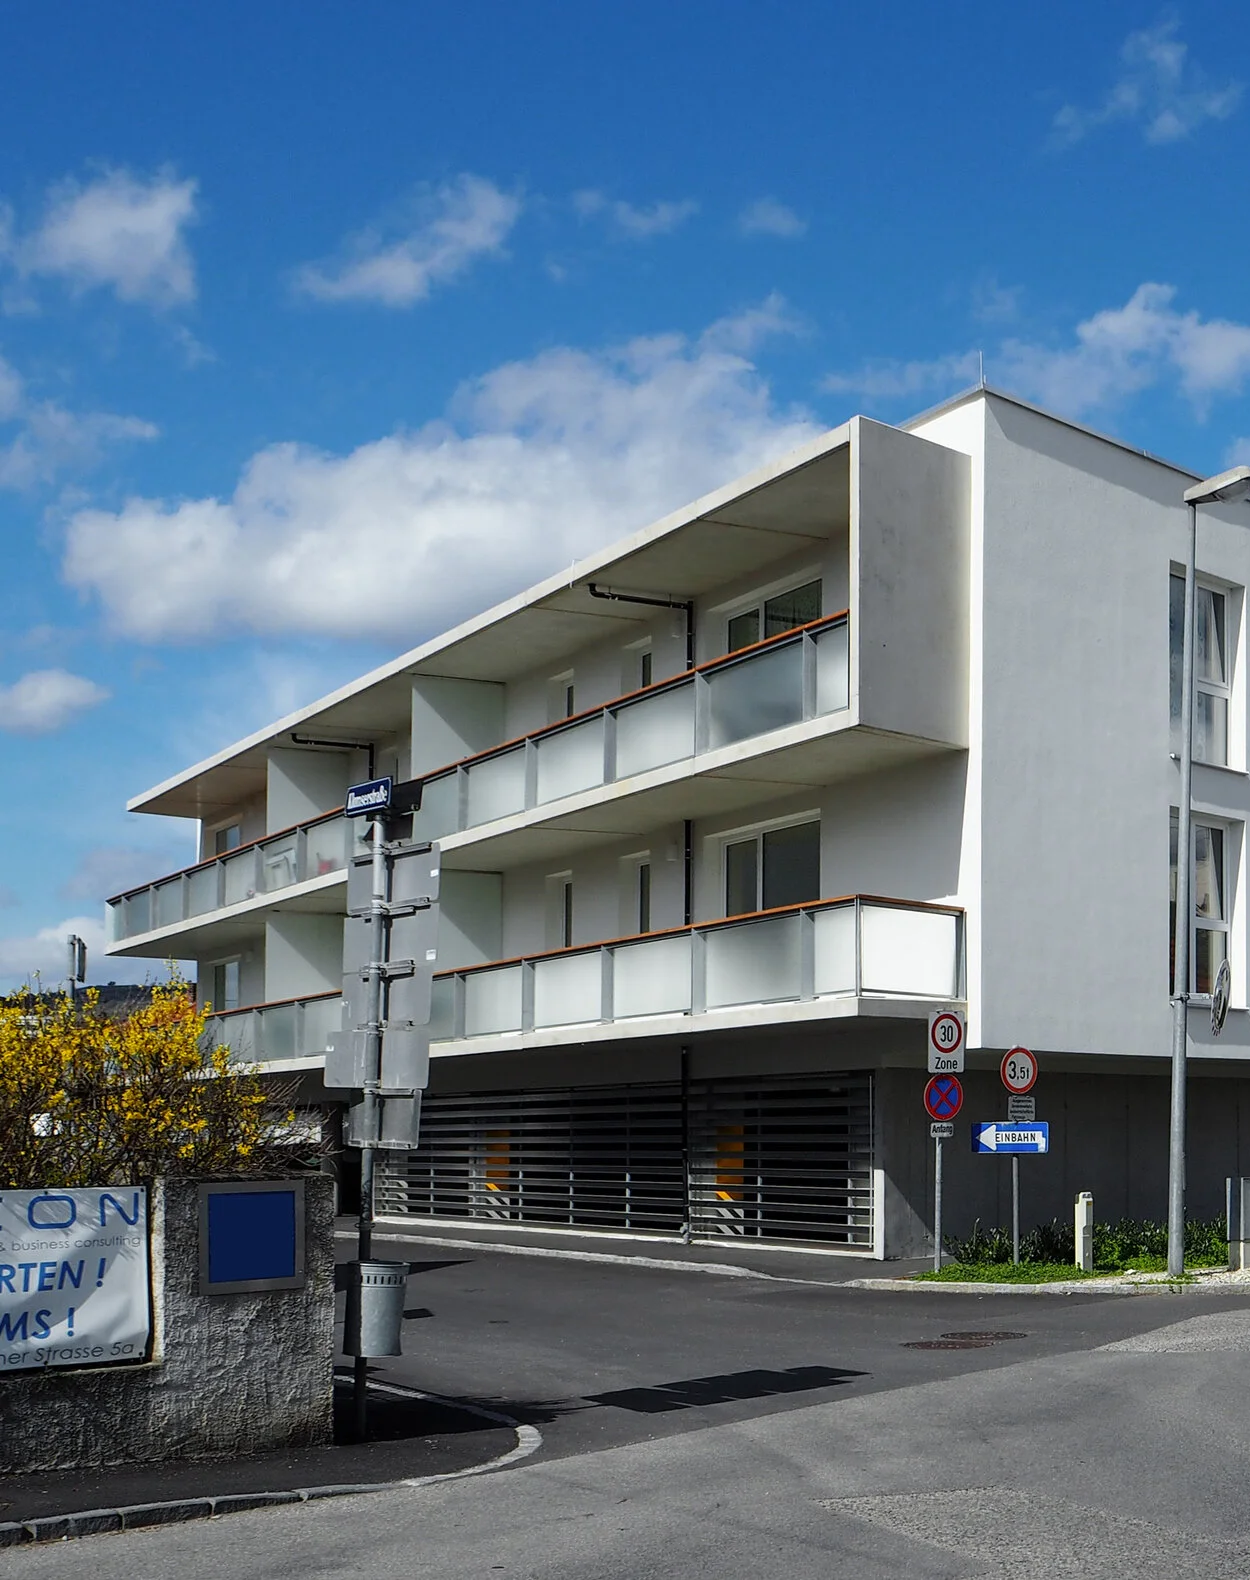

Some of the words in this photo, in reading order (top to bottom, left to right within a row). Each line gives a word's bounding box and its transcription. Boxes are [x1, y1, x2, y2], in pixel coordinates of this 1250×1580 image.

[940, 1025, 953, 1042] 30
[935, 1057, 958, 1069] Zone
[931, 1124, 953, 1135] Anfang
[995, 1133, 1036, 1142] EINBAHN
[12, 1239, 70, 1251] business
[75, 1235, 141, 1249] consulting
[34, 1346, 104, 1362] Strasse
[110, 1342, 134, 1356] 5a
